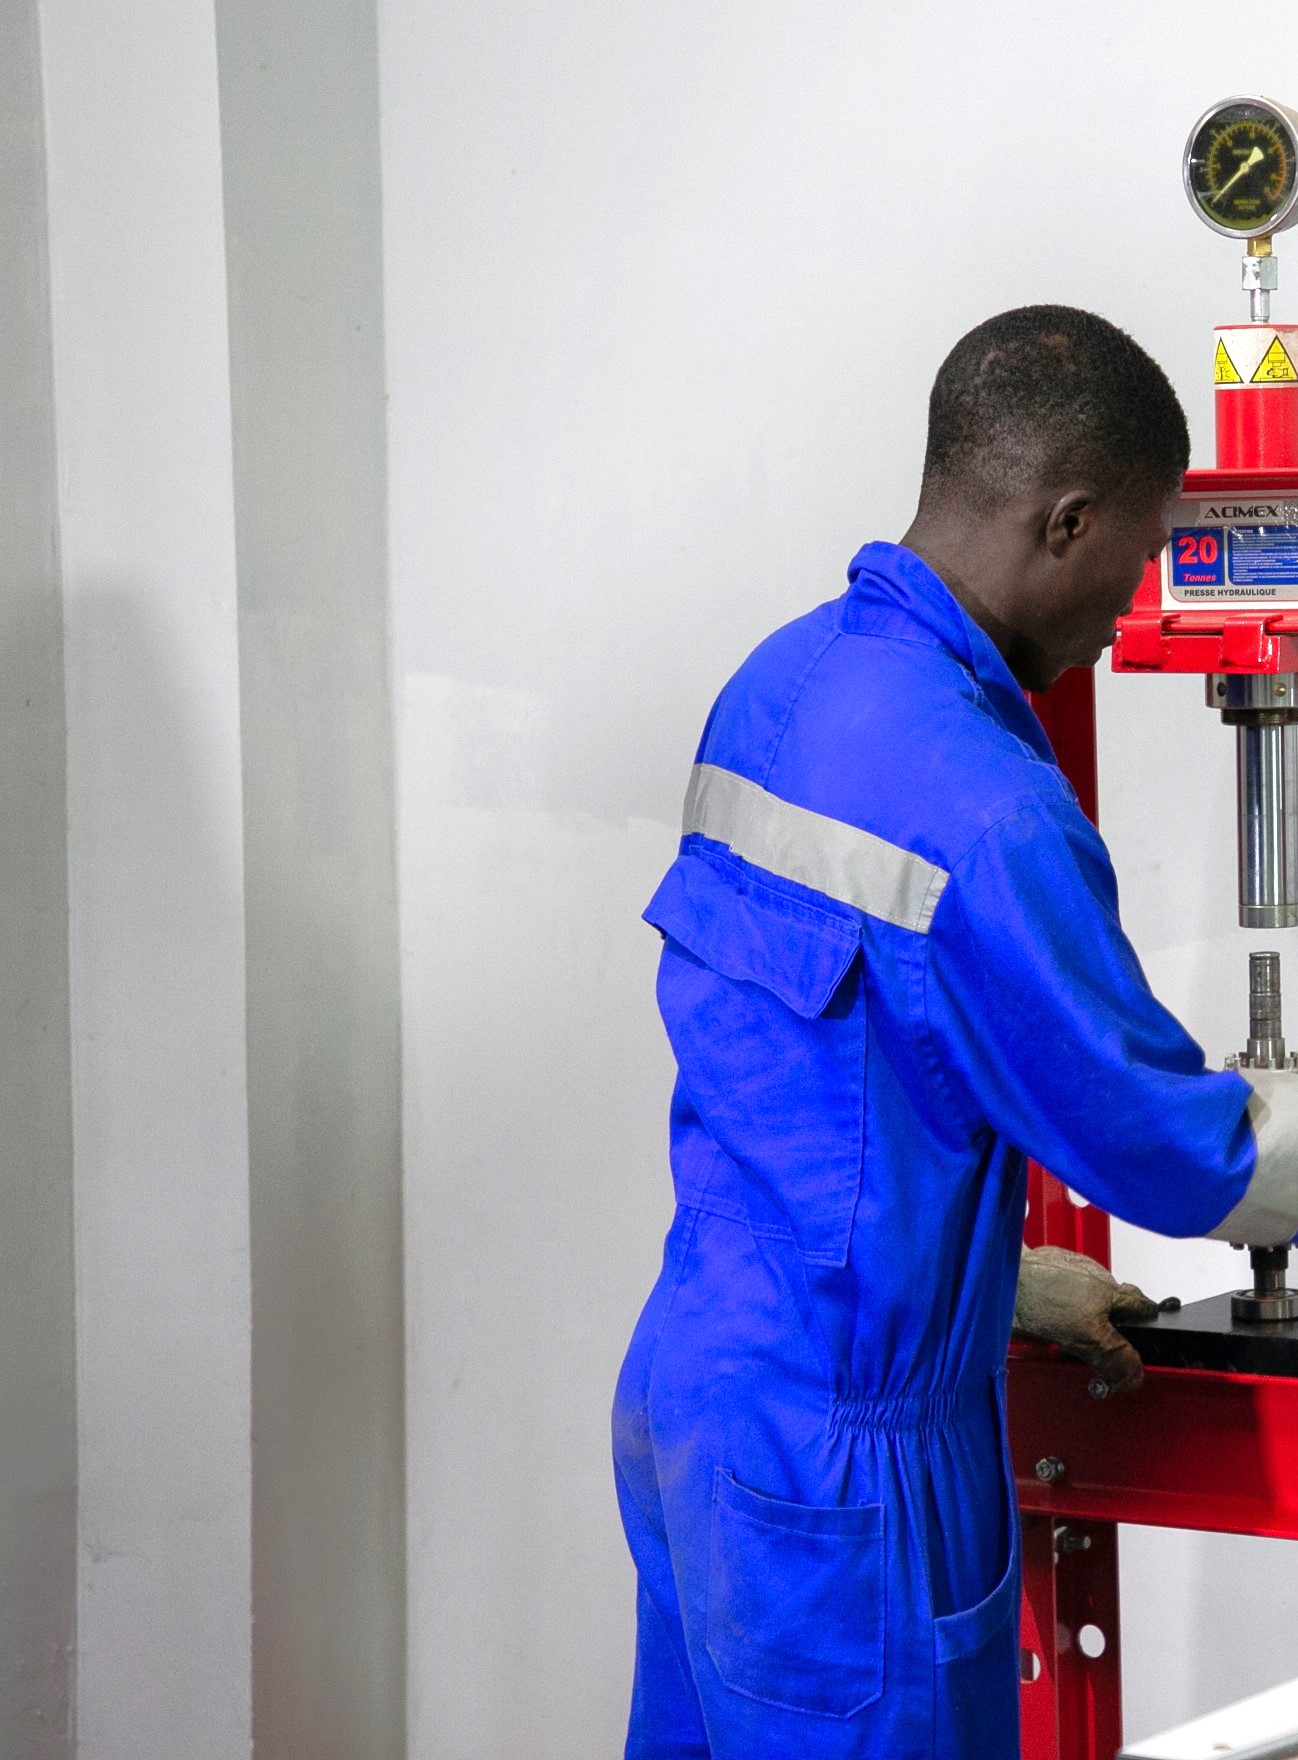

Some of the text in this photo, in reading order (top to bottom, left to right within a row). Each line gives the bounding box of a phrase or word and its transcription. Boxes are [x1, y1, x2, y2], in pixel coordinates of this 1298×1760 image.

[1204, 505, 1279, 519] ACIMEX
[1178, 536, 1218, 564] 20
[1184, 574, 1216, 582] Tonnes
[1184, 588, 1277, 597] PRESSE HYDRAULIQUE
